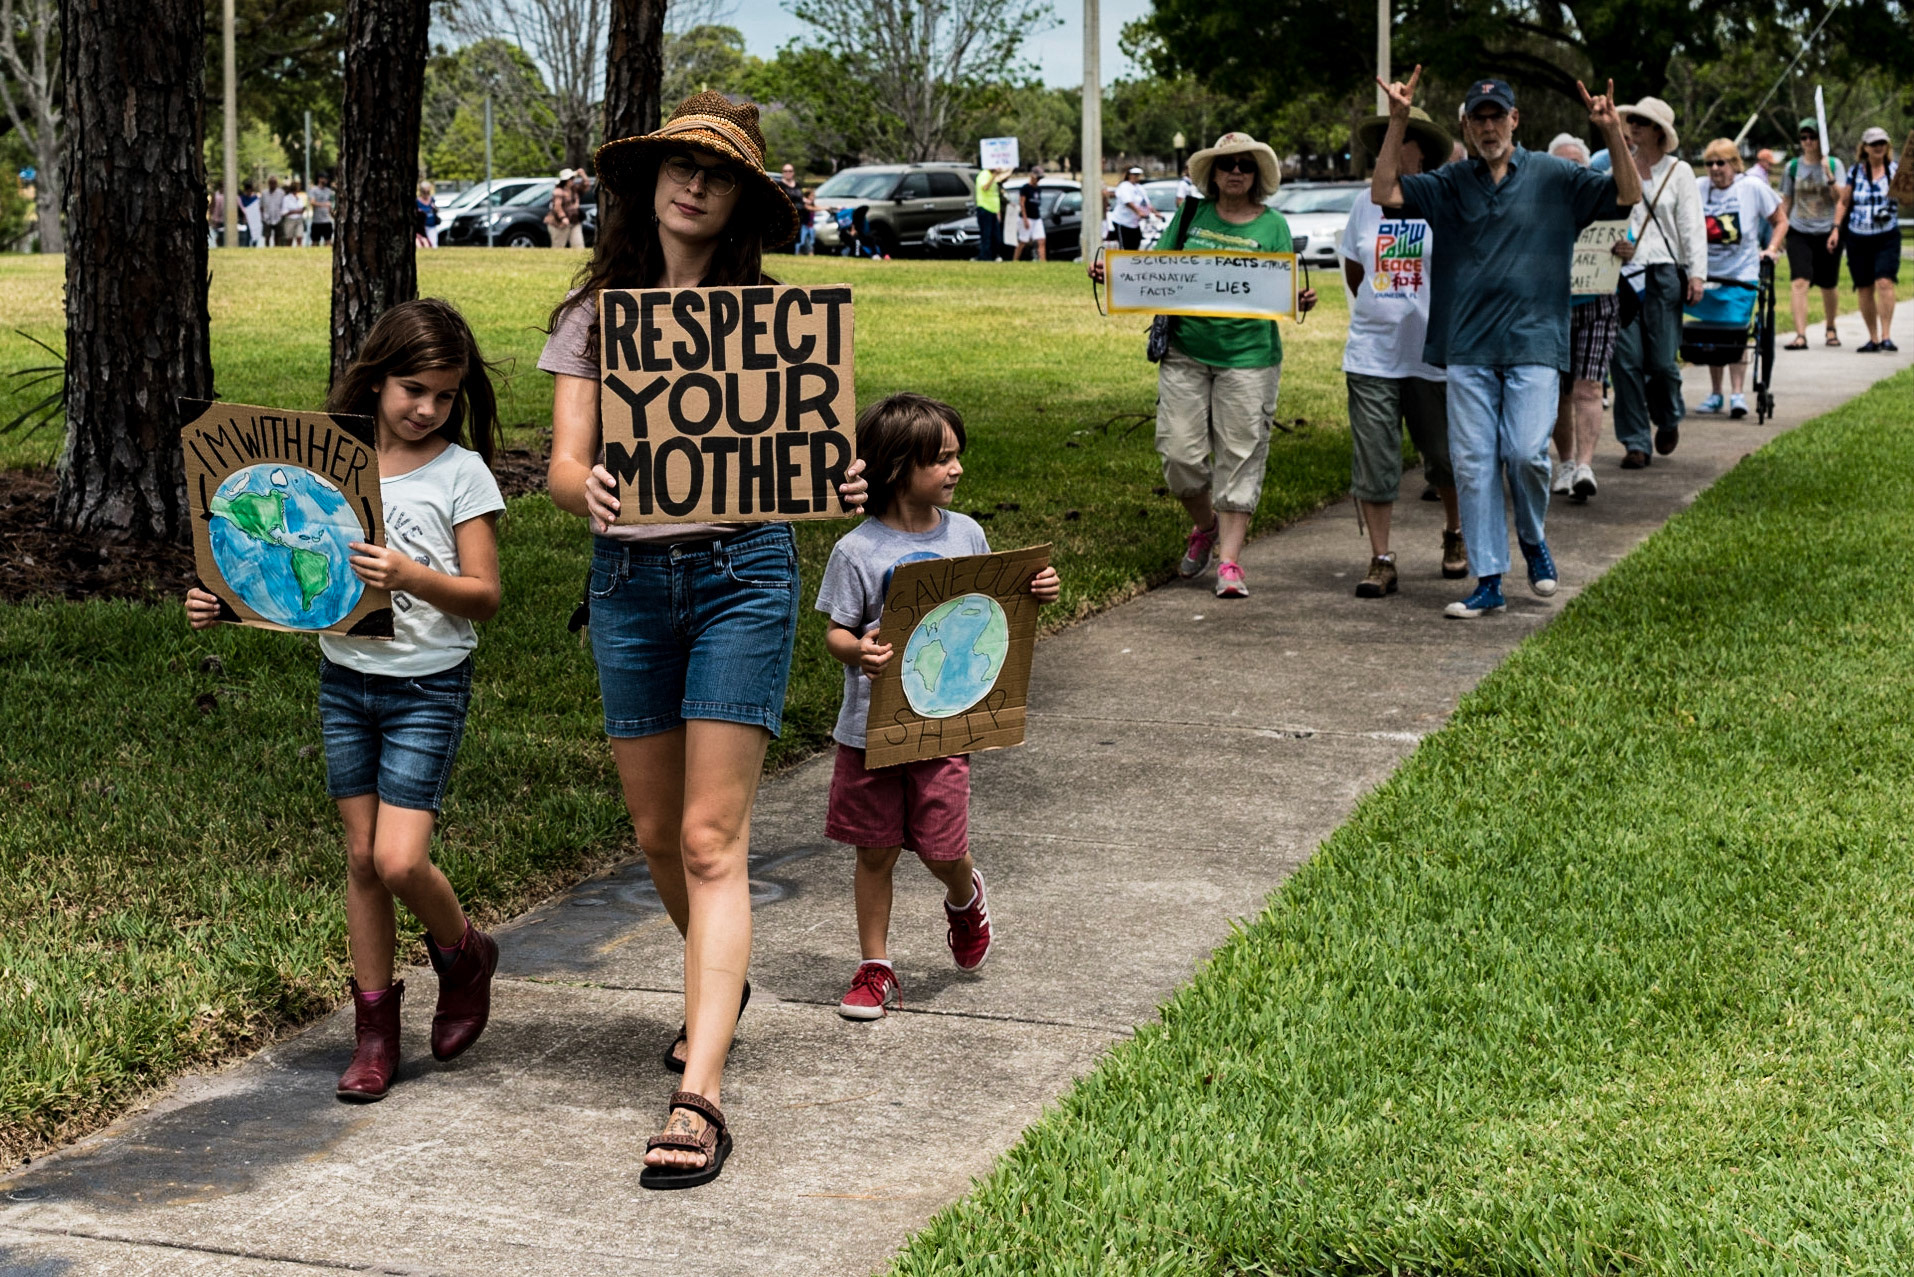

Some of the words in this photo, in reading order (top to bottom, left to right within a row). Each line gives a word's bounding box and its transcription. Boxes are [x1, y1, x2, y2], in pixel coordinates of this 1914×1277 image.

[1120, 272, 1198, 283] "ALTERNATIVE
[1130, 255, 1200, 266] SCIENCE
[1215, 257, 1258, 268] FACTS
[1140, 285, 1184, 297] FACTS"
[1215, 281, 1251, 294] LIES
[603, 288, 852, 372] RESPECT
[603, 362, 841, 439] YOUR
[188, 422, 246, 478] I'M
[229, 415, 303, 463] WITH
[307, 423, 369, 496] HER
[605, 430, 853, 517] MOTHER
[384, 502, 424, 544] IVE
[890, 559, 970, 630] SAVE
[884, 688, 1007, 752] SHIP
